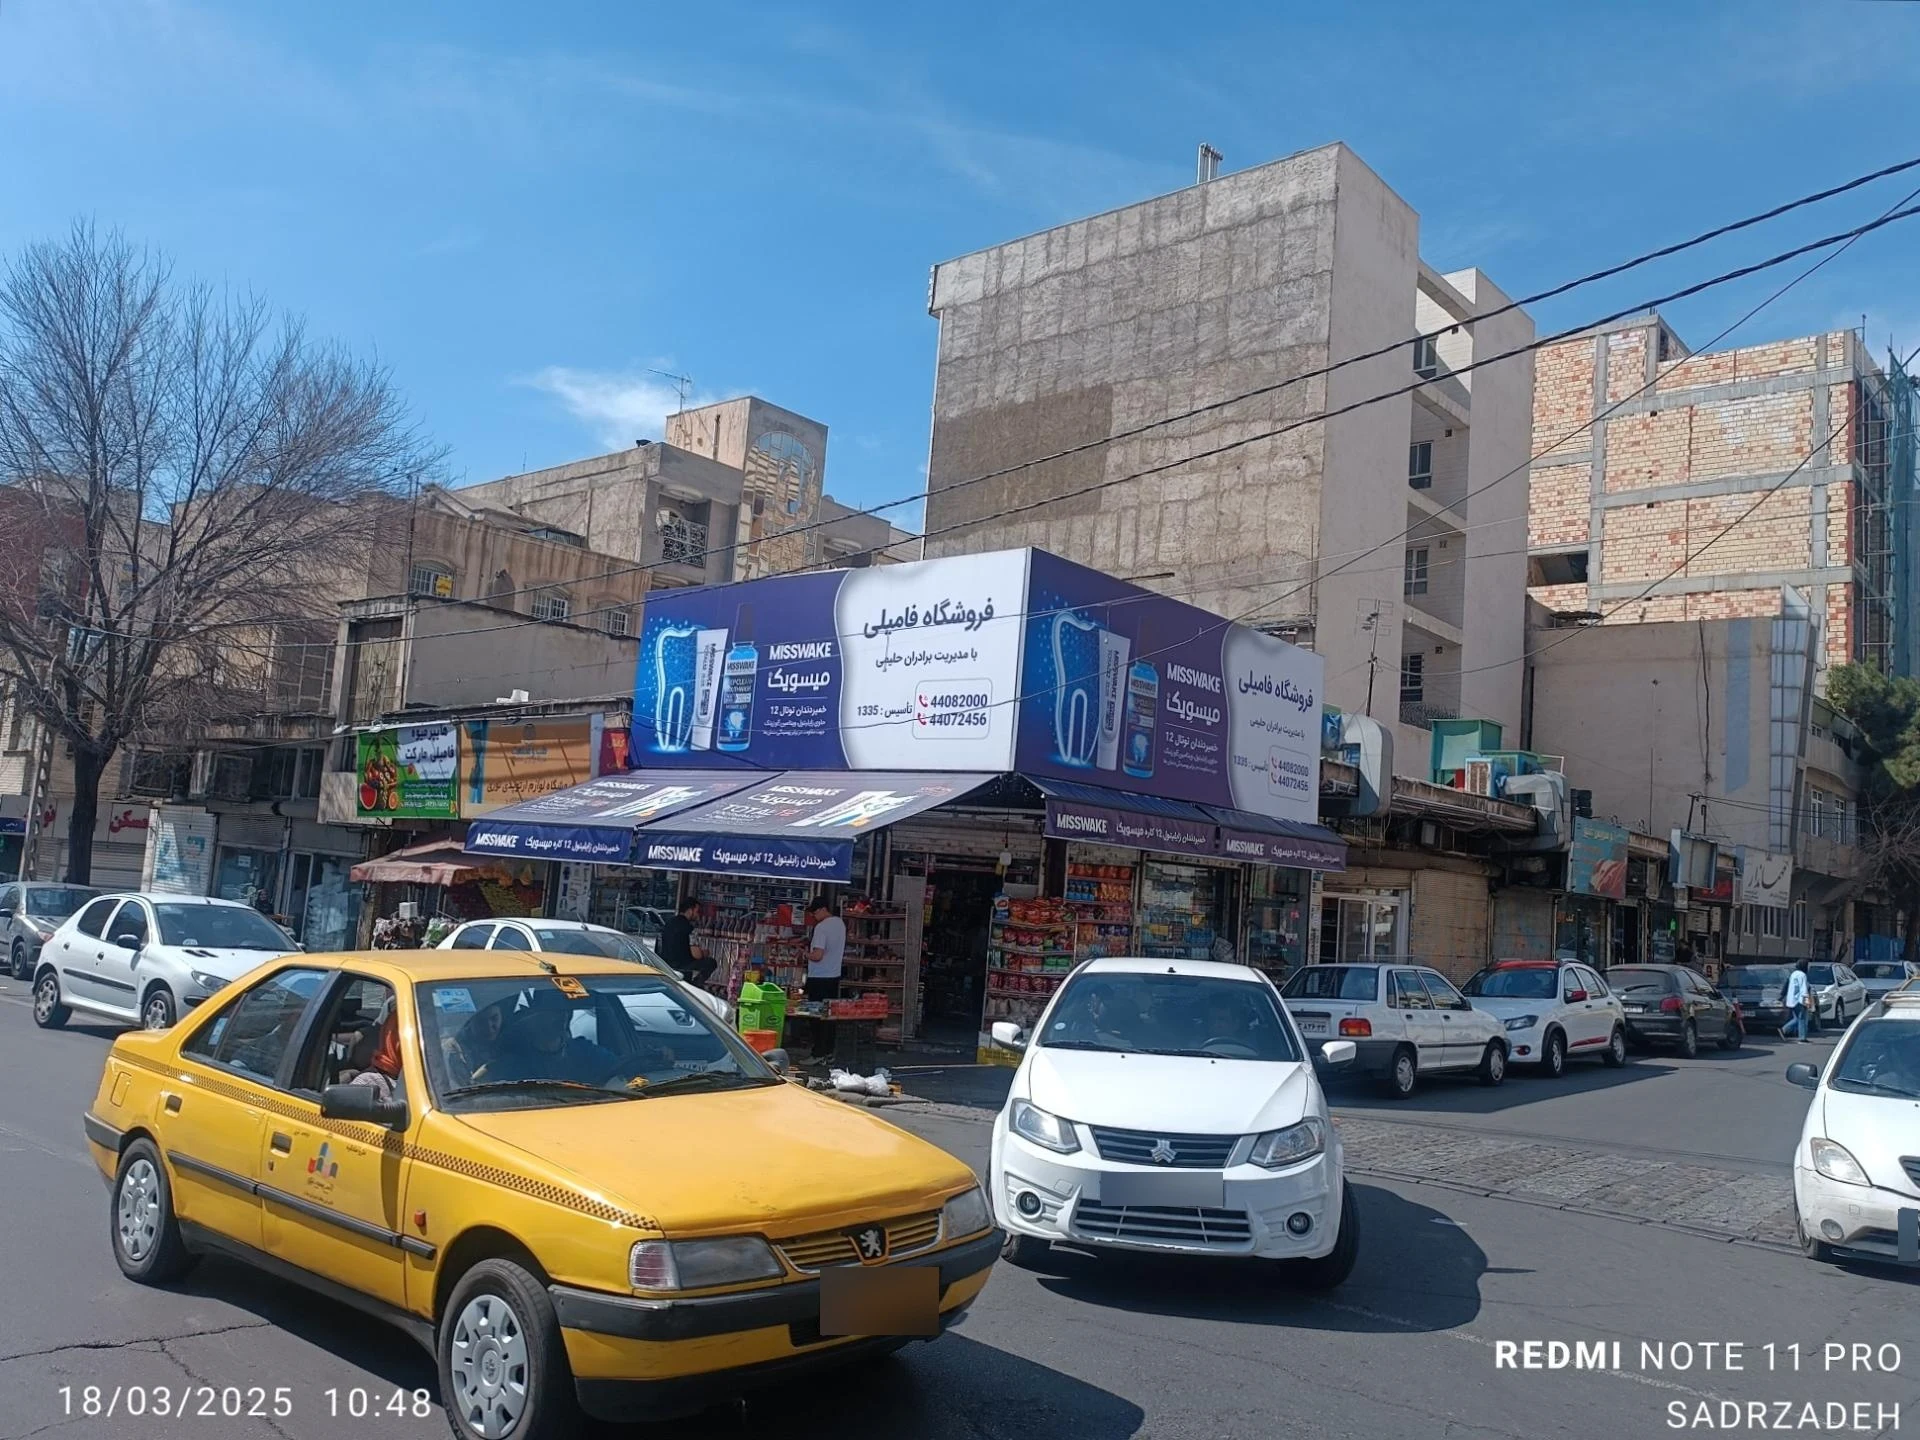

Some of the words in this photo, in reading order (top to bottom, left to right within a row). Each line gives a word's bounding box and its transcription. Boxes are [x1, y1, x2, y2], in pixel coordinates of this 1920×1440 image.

[863, 604, 918, 638] فامیلی
[923, 597, 994, 631] فروشگاه
[769, 642, 831, 660] MISSWAKE
[904, 650, 932, 666] برادران
[935, 650, 968, 664] مدیریت
[971, 648, 978, 661] با
[768, 667, 830, 693] میسویک
[1167, 662, 1221, 694] MISSWAKE
[1238, 670, 1272, 696] فامیلی
[930, 694, 988, 708] 44082000
[1274, 679, 1313, 712] فروشگاه
[770, 705, 779, 714] 12
[857, 705, 879, 716] 1335
[1167, 690, 1220, 725] میسویک
[929, 713, 987, 726] 44072456
[1165, 731, 1174, 742] 12
[430, 744, 455, 763] فامیلی
[528, 780, 545, 793] لوازم
[1057, 813, 1108, 834] MISSWAKE
[1116, 821, 1144, 839] میسویک
[475, 833, 520, 848] MISSWAKE
[1155, 829, 1162, 838] 12
[525, 836, 552, 850] میسویک
[564, 839, 571, 848] 12
[1226, 839, 1265, 856] MISSWAKE
[648, 844, 703, 863] MISSWAKE
[712, 848, 748, 864] میسویک
[749, 852, 762, 864] کاره
[763, 853, 773, 864] 12
